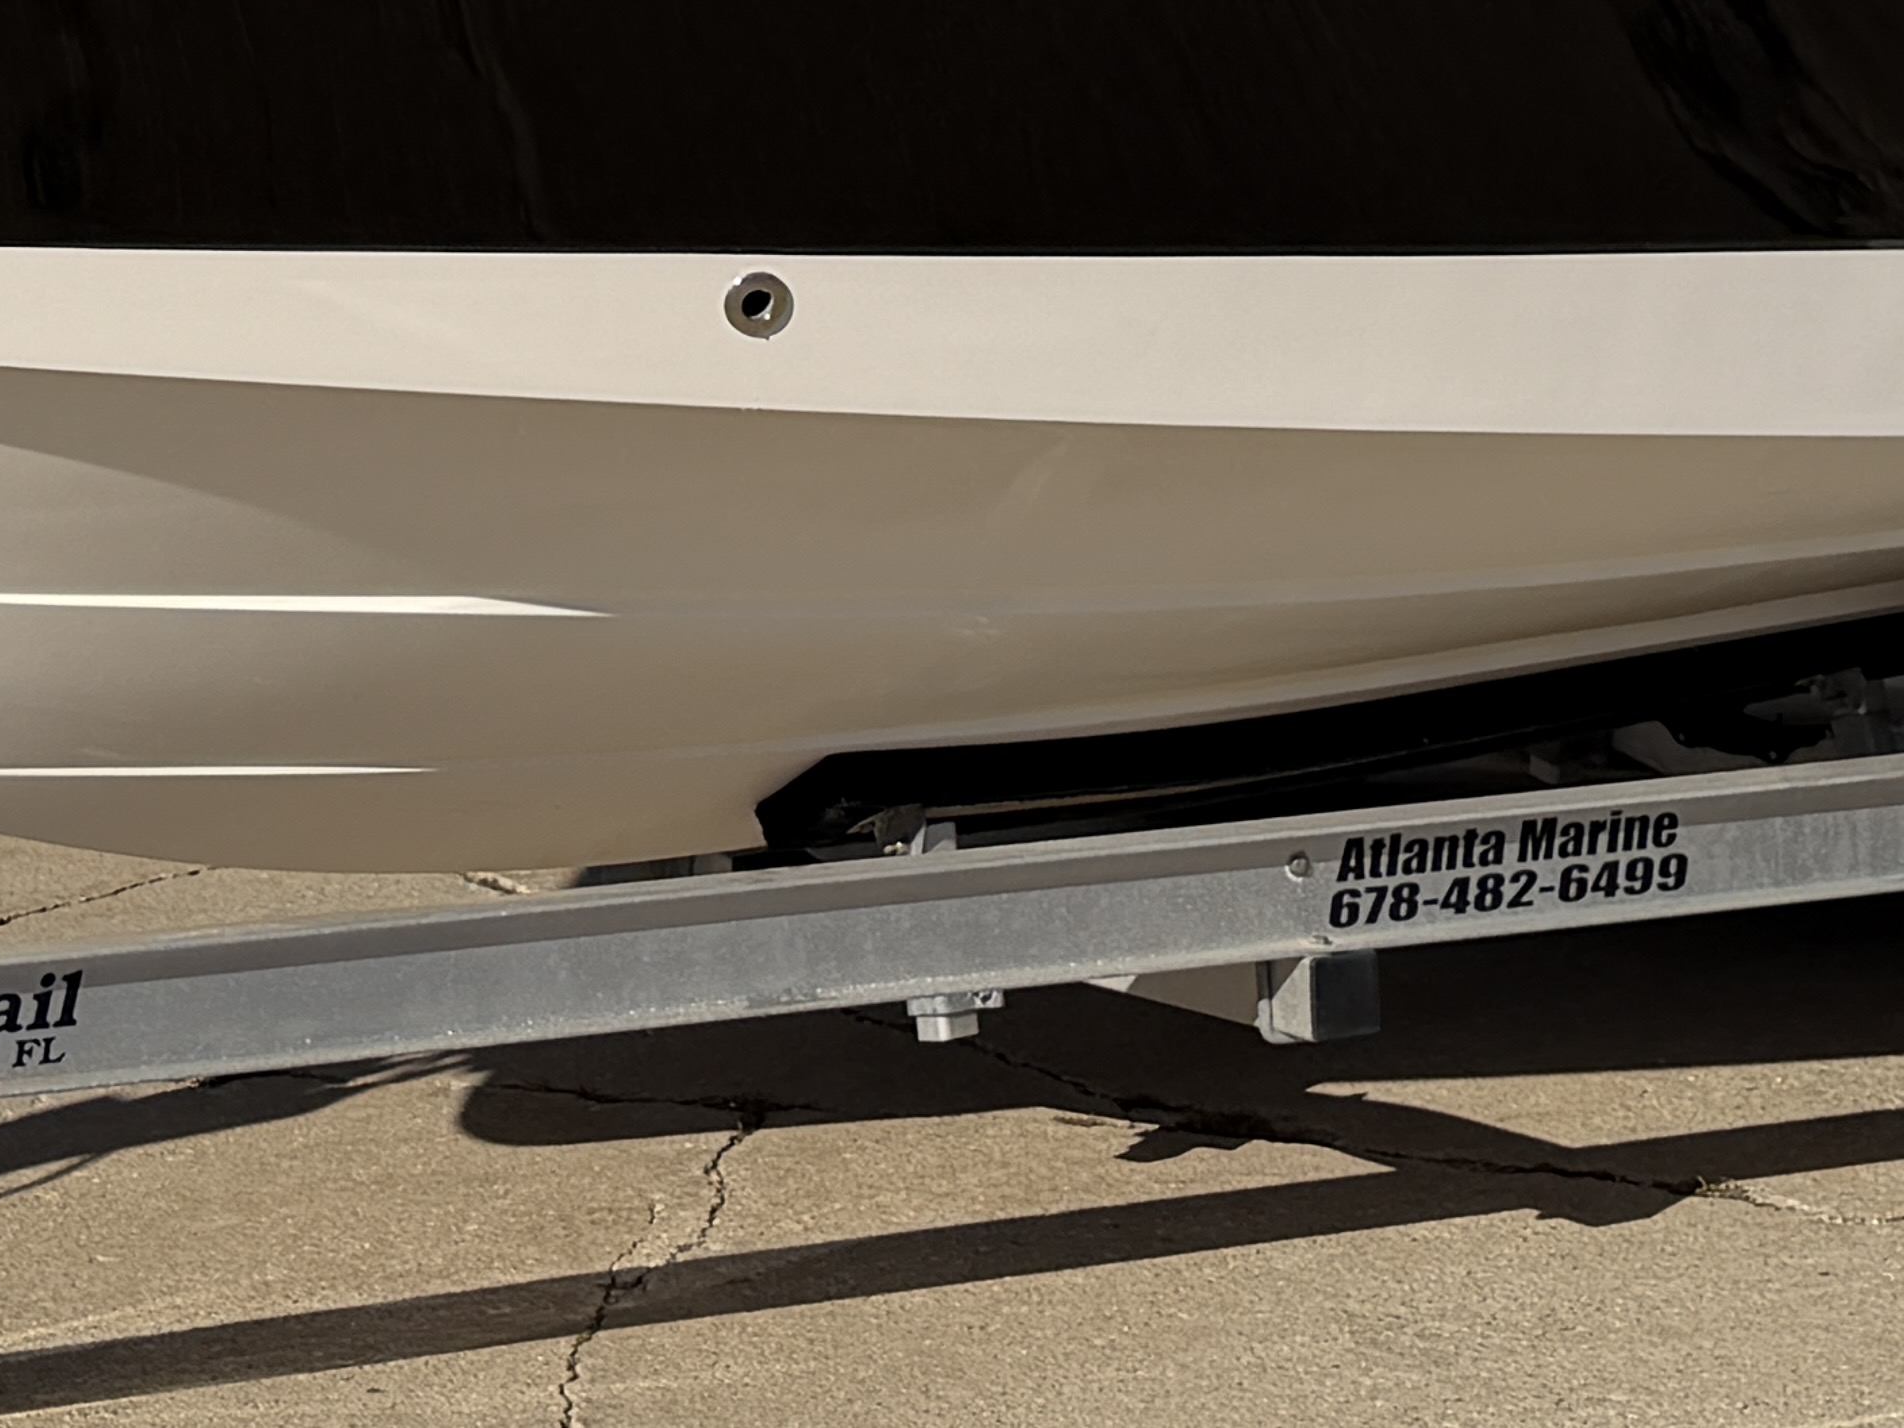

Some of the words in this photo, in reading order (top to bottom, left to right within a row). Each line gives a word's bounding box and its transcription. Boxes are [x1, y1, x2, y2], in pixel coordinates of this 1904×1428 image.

[1337, 828, 1506, 882] Atlanta
[1517, 811, 1680, 864] Marine
[1329, 852, 1688, 929] 678-482-6499
[12, 1037, 67, 1069] FL
